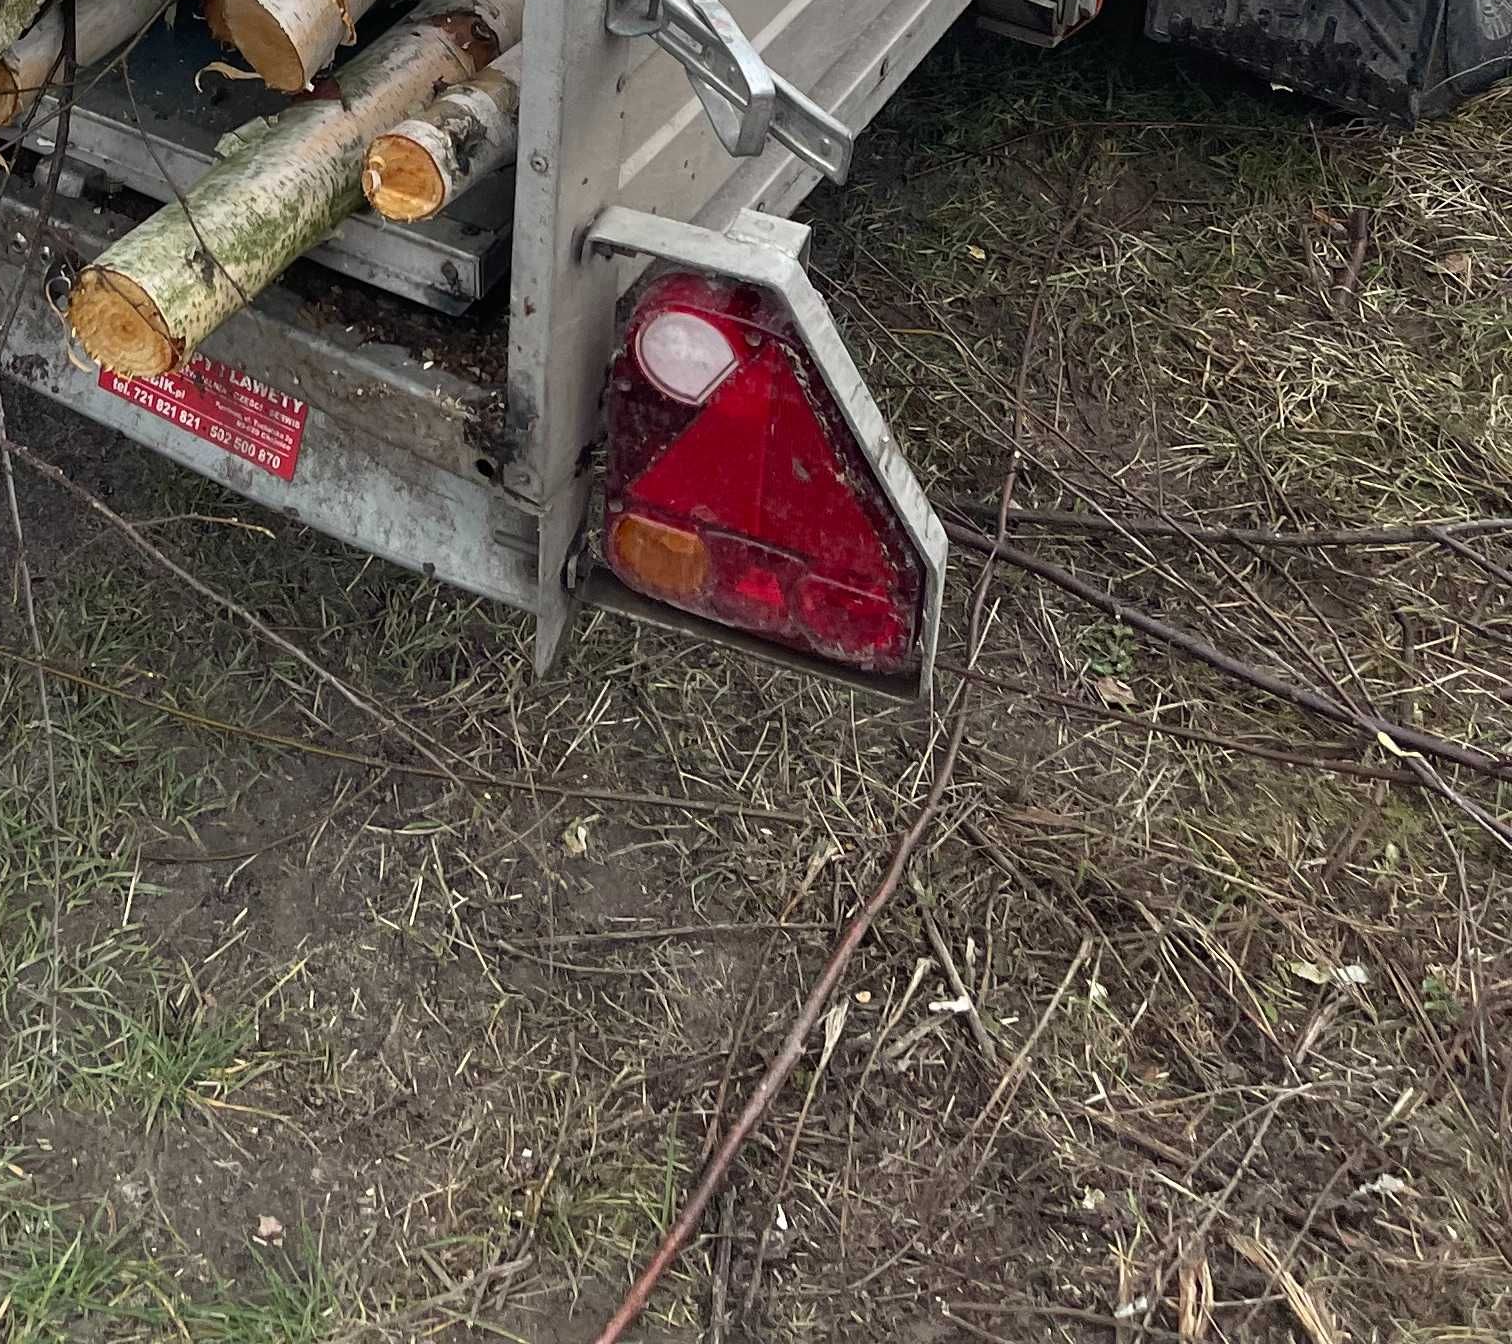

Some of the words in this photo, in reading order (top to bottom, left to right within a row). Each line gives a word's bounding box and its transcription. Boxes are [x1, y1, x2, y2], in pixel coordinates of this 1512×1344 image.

[112, 377, 130, 396] tel.
[133, 386, 153, 408] 721
[156, 398, 177, 419] 821
[179, 409, 201, 431] 821
[209, 425, 232, 445] 502
[233, 435, 256, 457] 500
[257, 448, 281, 469] 870
[229, 370, 304, 414] LAWETY
